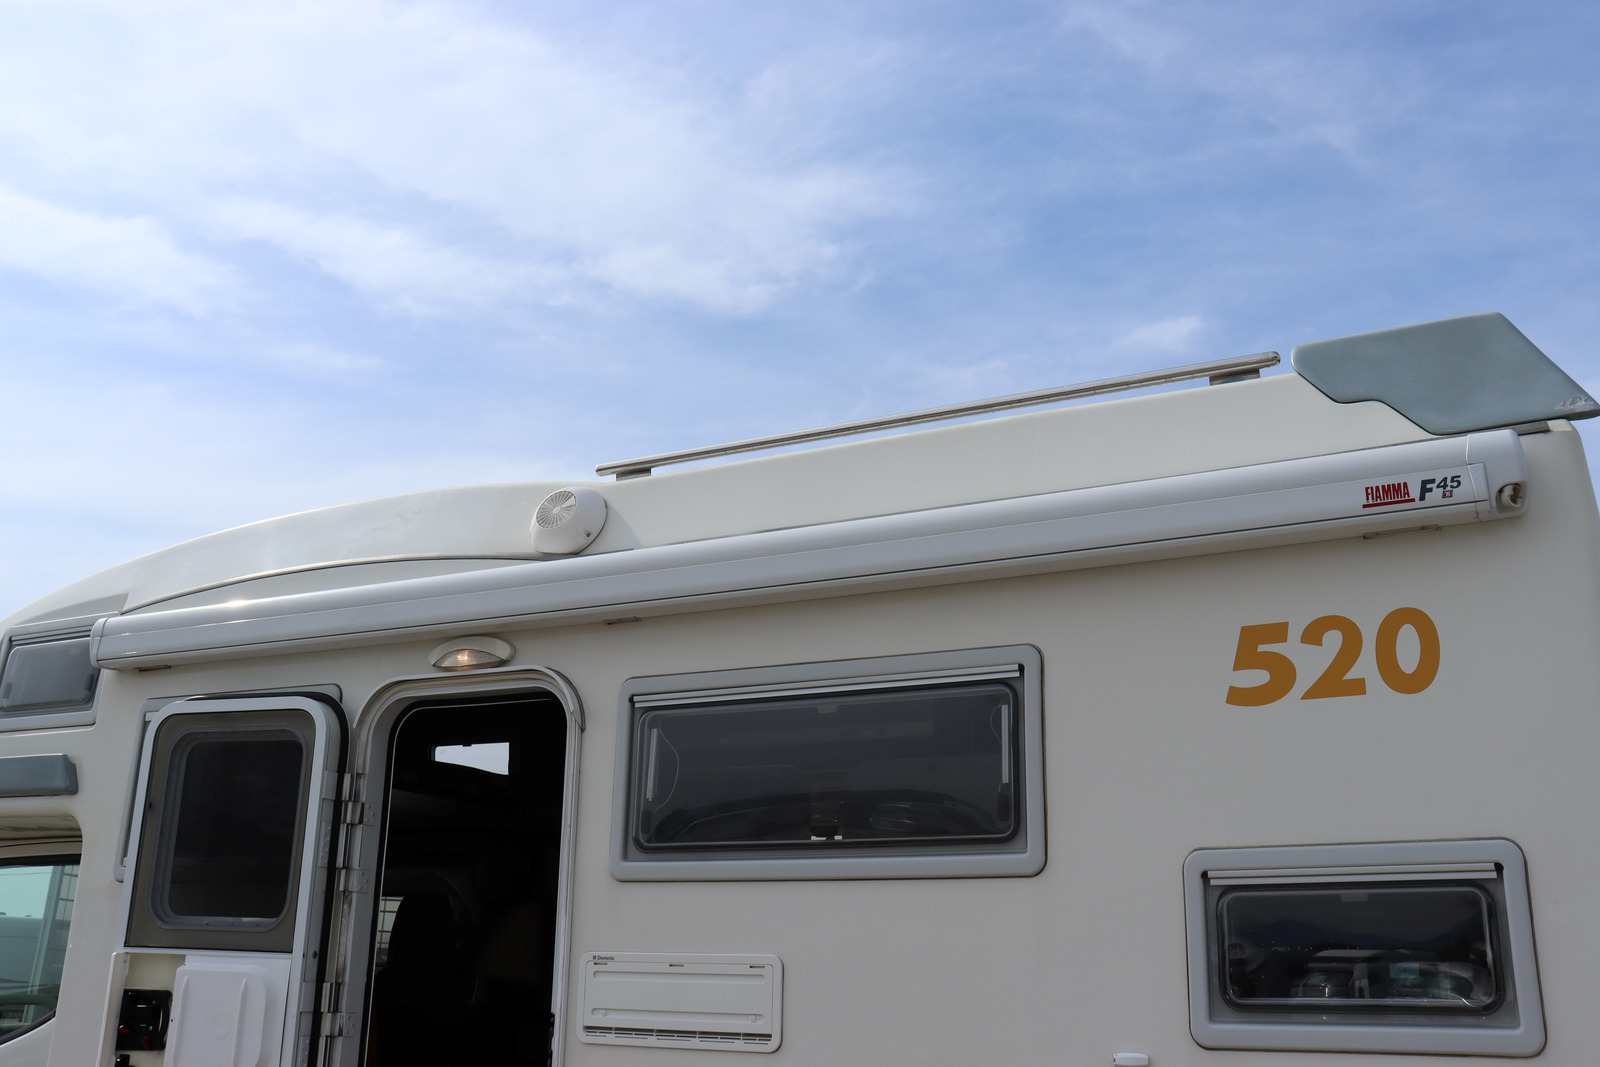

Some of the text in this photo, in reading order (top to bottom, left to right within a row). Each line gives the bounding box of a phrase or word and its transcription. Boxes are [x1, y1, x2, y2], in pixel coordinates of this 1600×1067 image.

[1365, 474, 1462, 504] FIAMMA F45
[1225, 606, 1441, 707] 520
